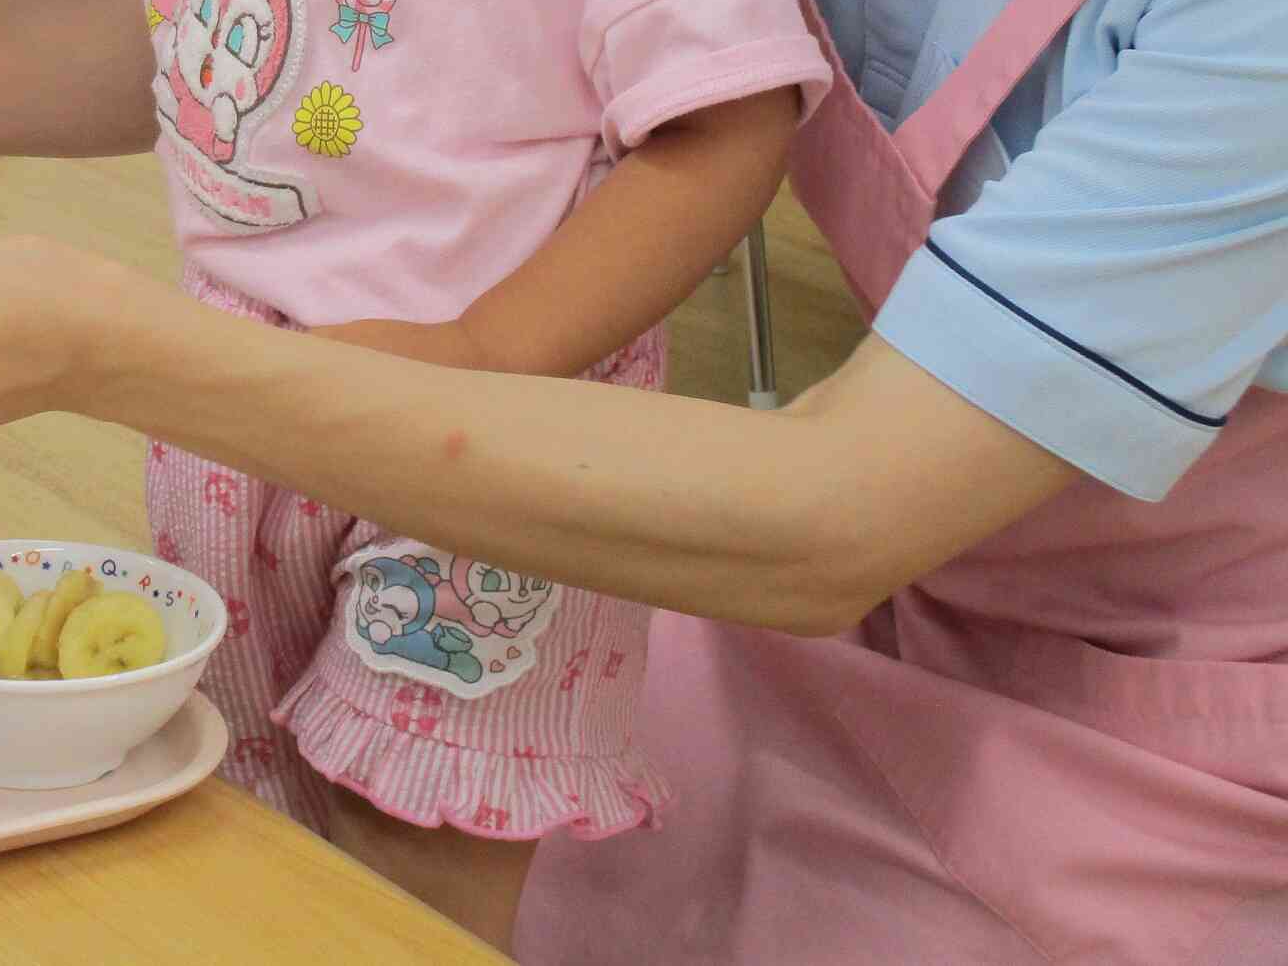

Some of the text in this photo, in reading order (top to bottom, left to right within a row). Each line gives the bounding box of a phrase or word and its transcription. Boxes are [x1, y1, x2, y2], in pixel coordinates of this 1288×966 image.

[24, 550, 41, 565] O
[101, 558, 117, 577] Q
[165, 590, 174, 607] S
